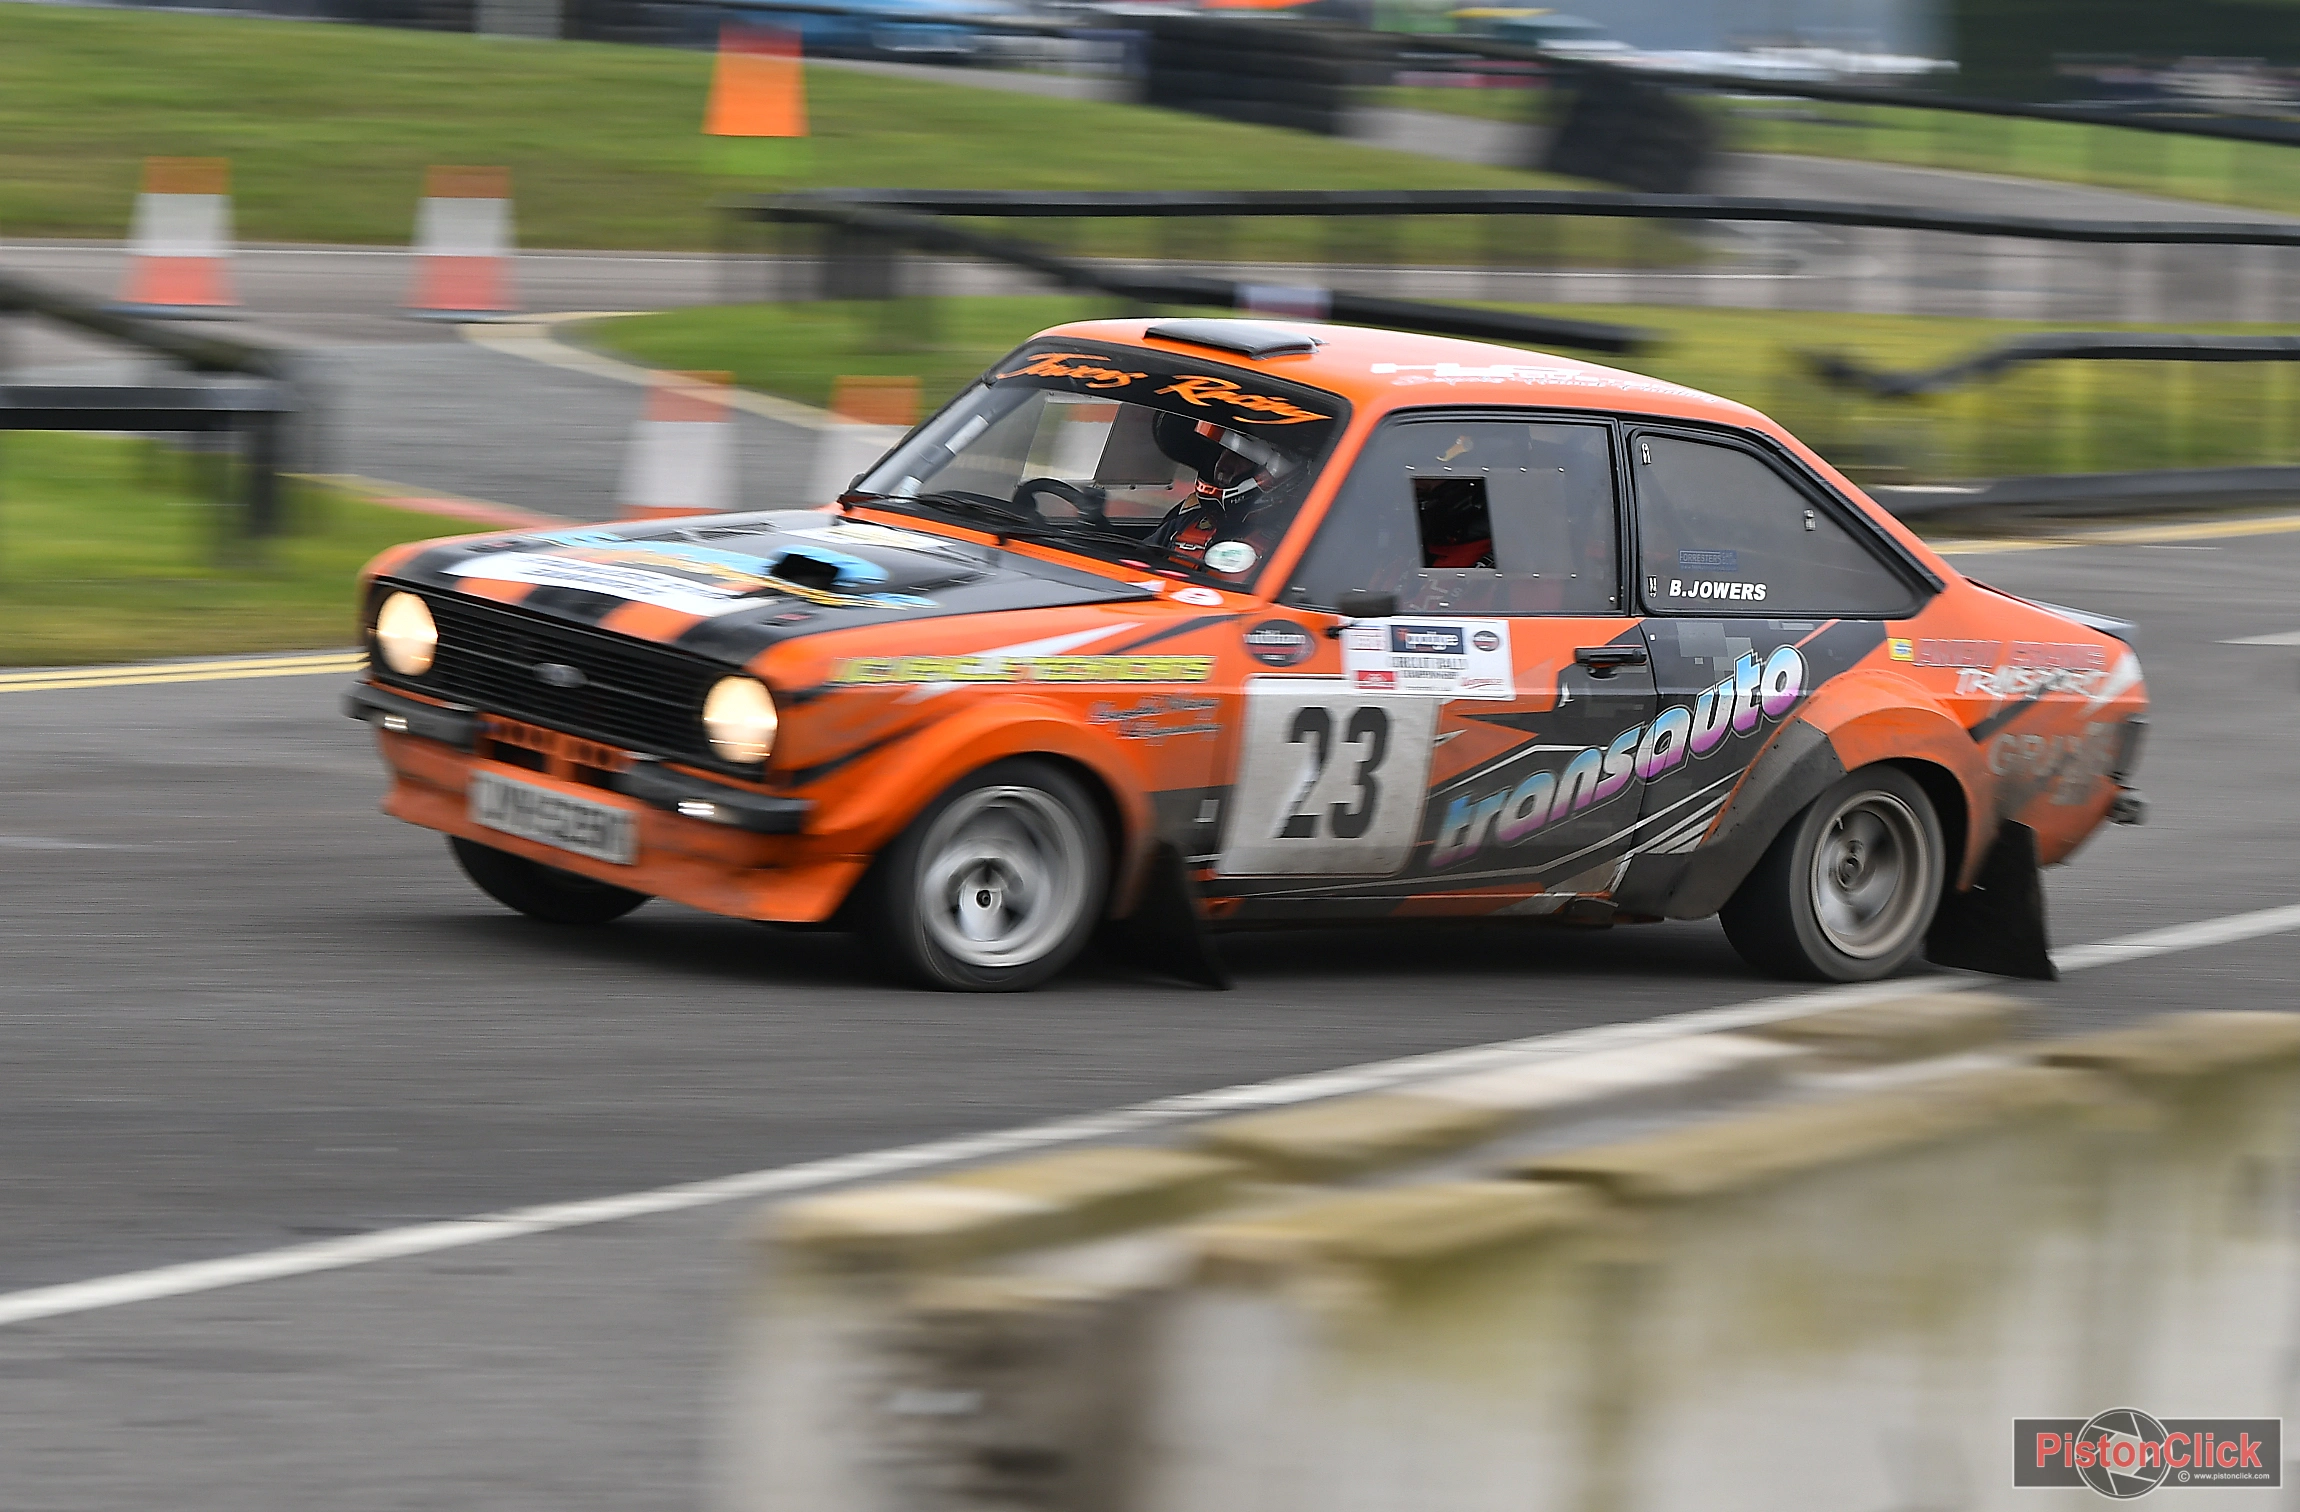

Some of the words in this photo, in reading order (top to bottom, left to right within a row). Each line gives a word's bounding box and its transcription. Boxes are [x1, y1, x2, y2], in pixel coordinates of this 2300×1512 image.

[1154, 375, 1333, 425] Racing
[1668, 579, 1767, 601] B.JOWERS
[1271, 705, 1393, 839] 23
[1427, 644, 1806, 868] transauto
